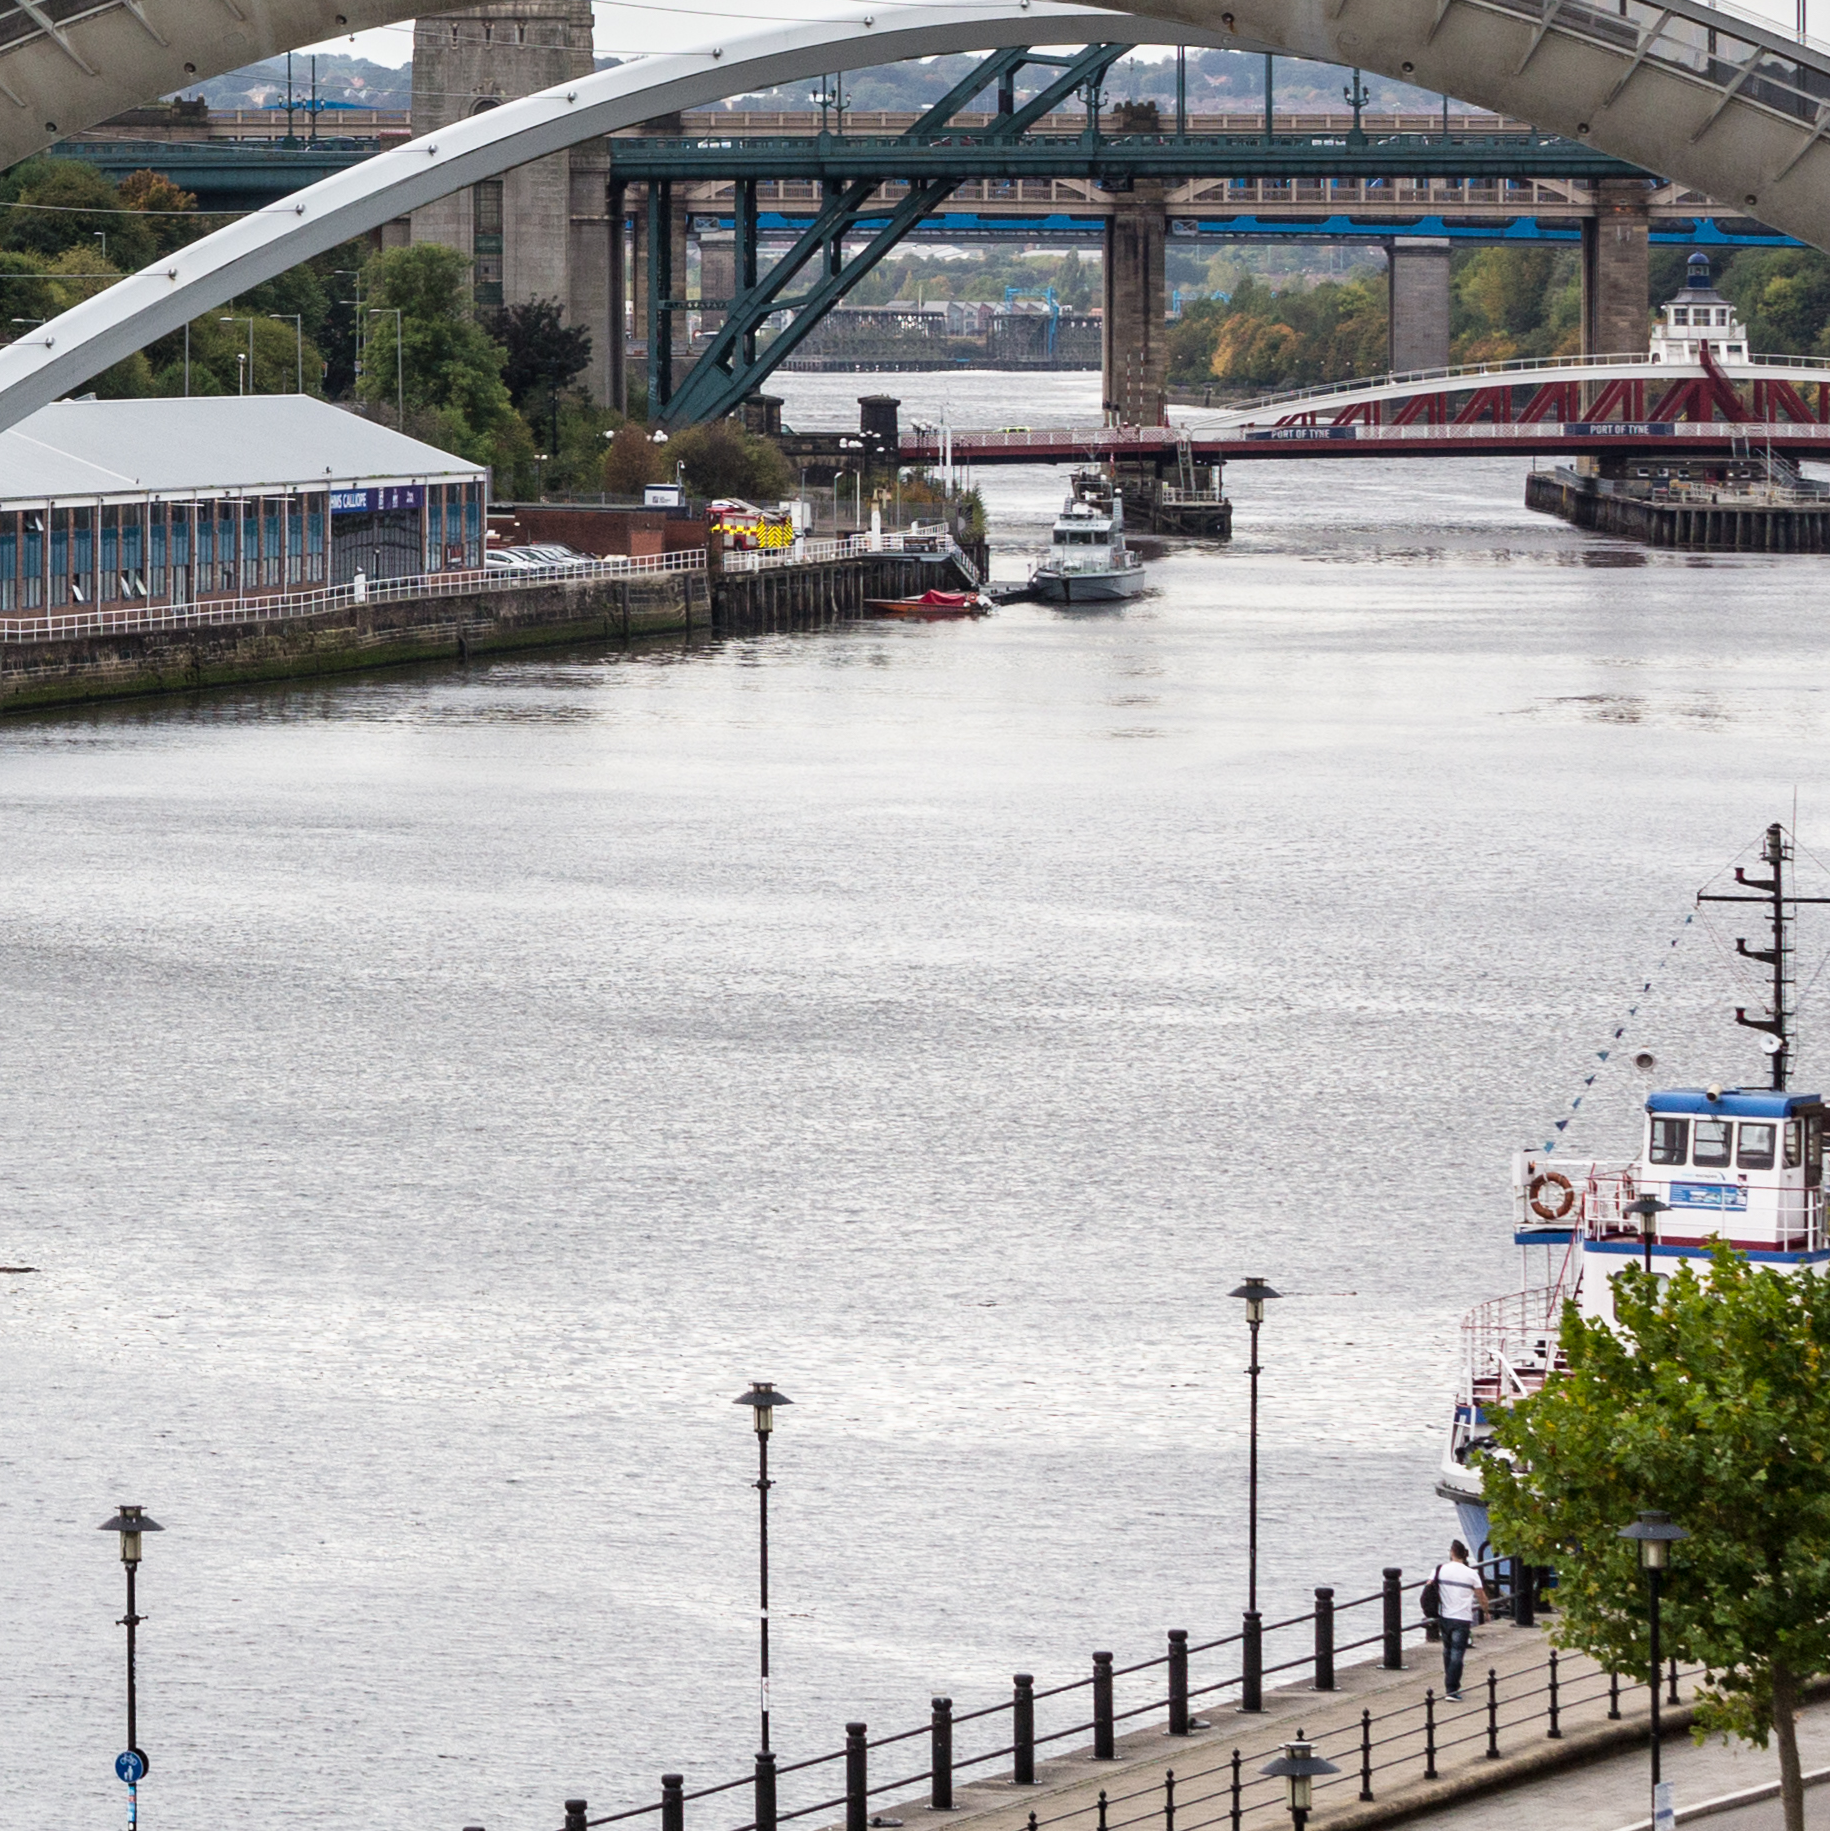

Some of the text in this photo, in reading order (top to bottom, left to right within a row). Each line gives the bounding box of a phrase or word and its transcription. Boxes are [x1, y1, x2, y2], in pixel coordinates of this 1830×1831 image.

[1271, 429, 1330, 439] PORT OF TYNE
[1590, 424, 1650, 434] PORT OF TYNE
